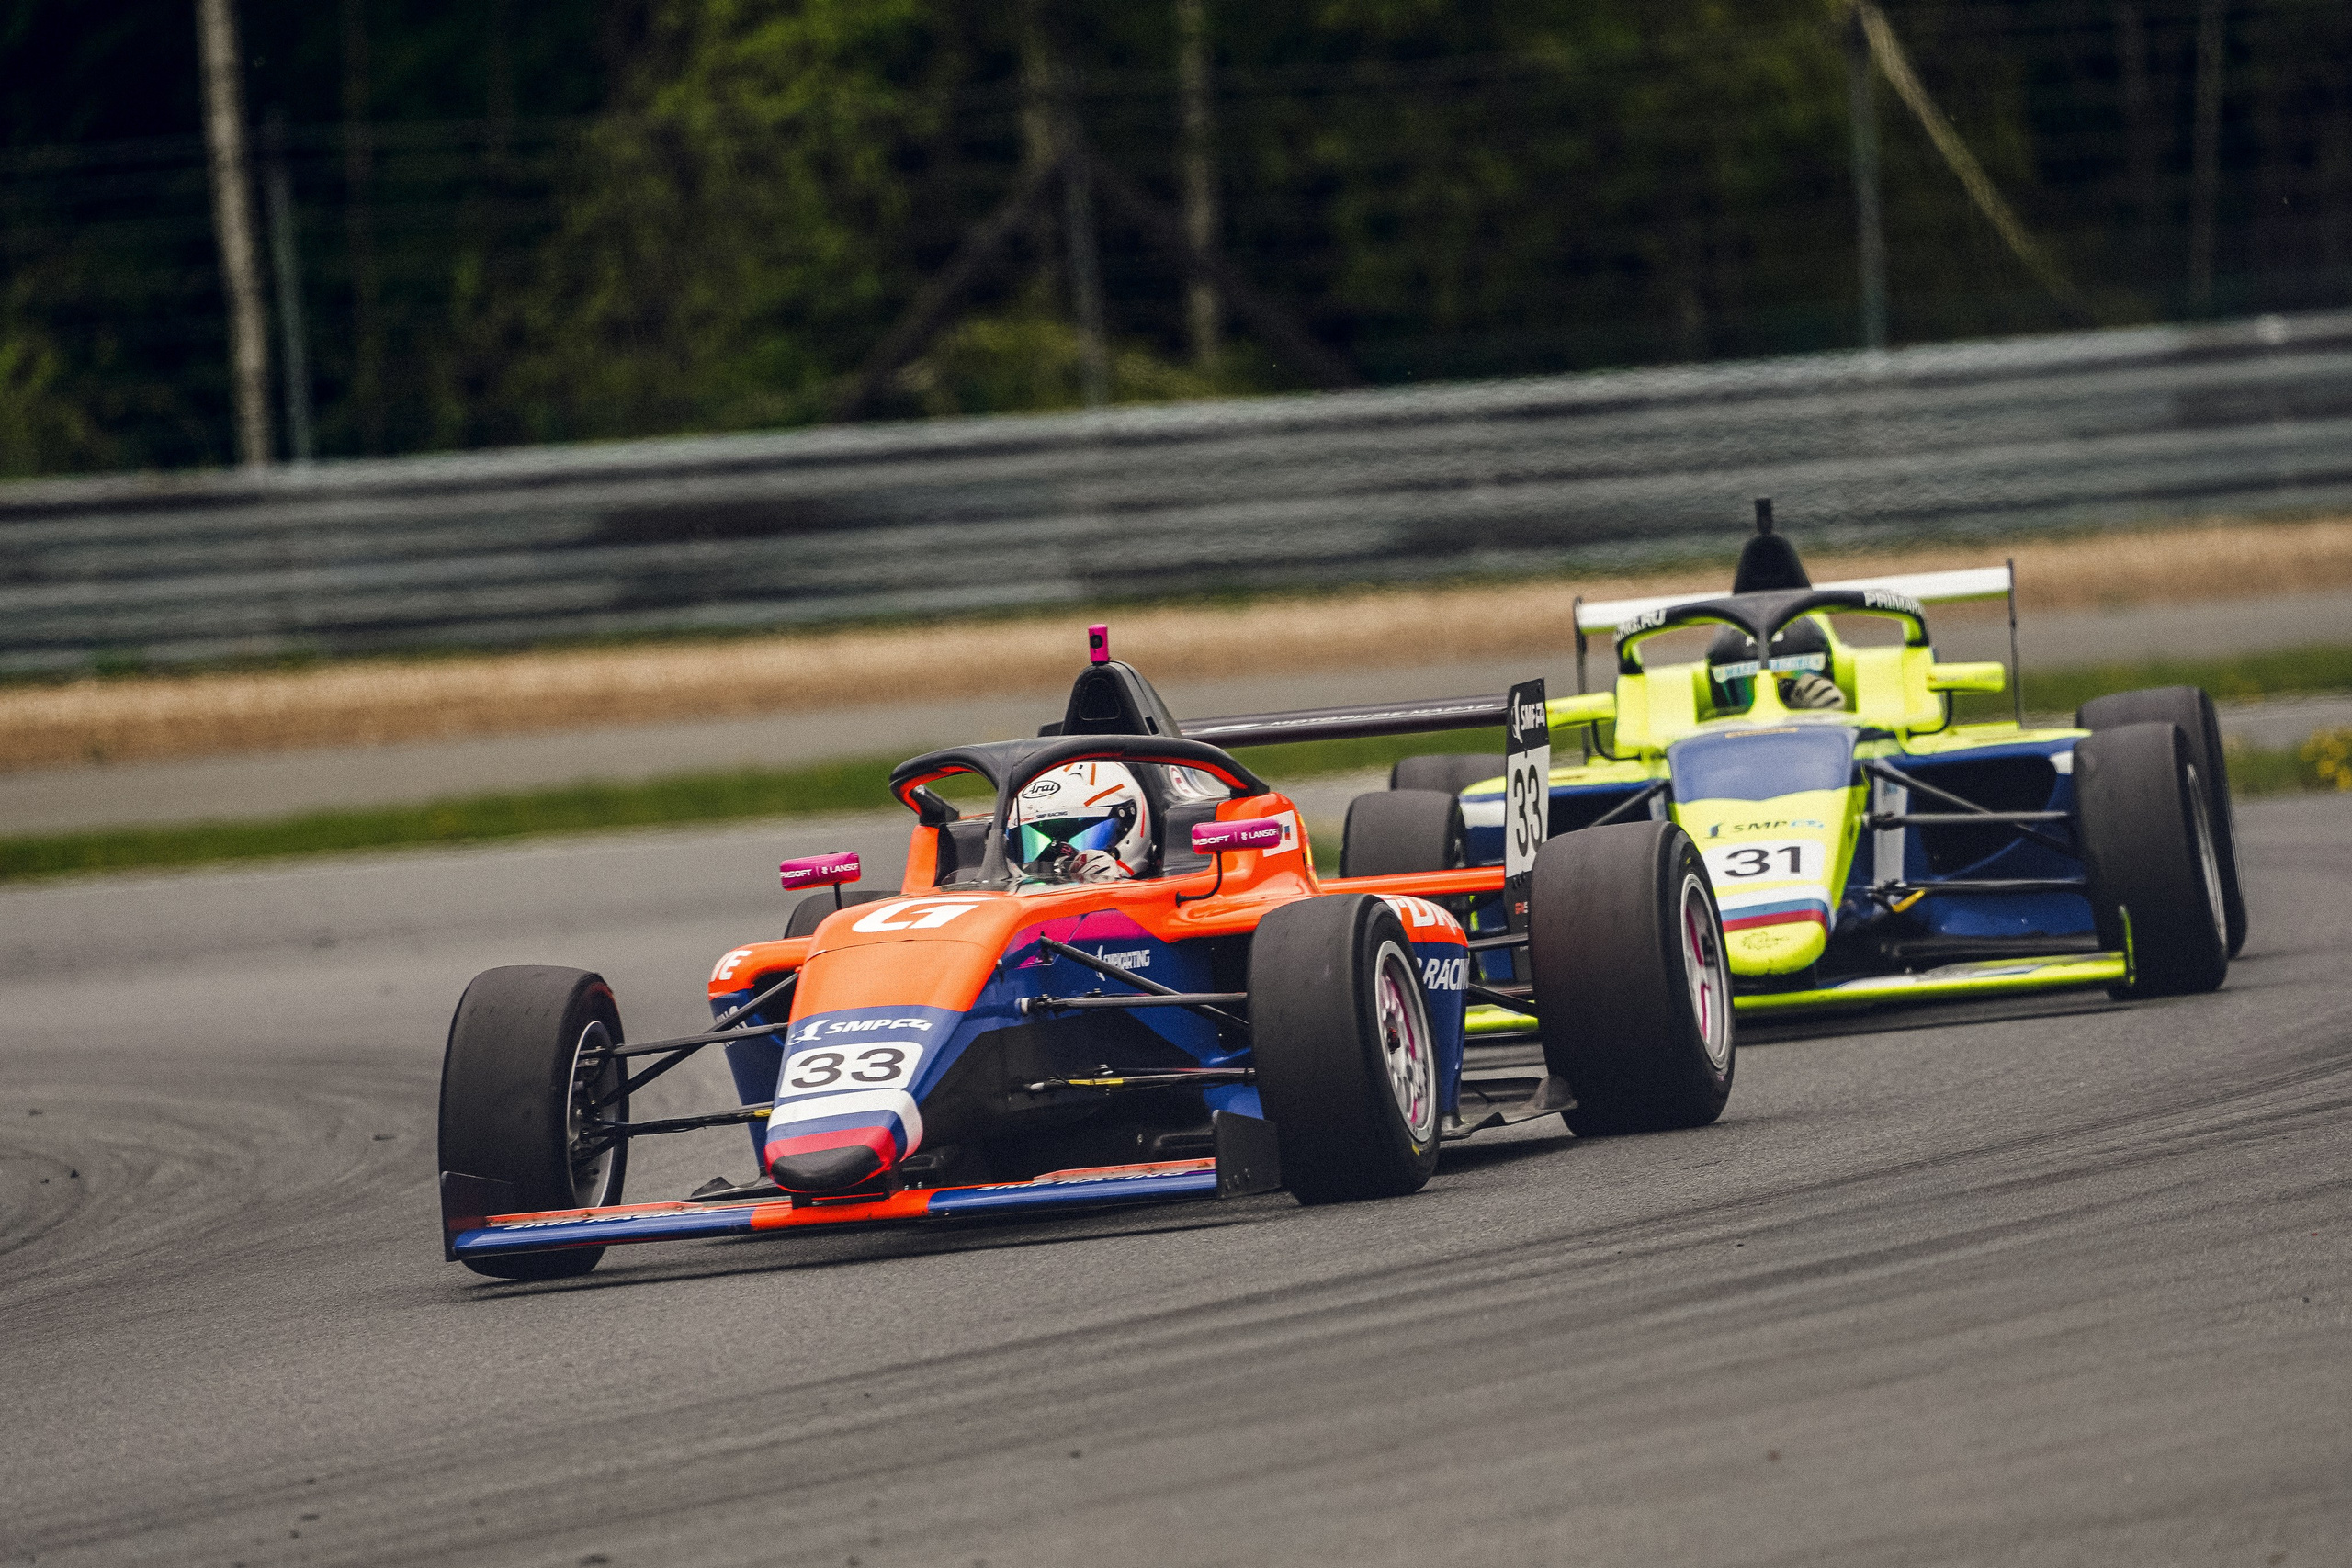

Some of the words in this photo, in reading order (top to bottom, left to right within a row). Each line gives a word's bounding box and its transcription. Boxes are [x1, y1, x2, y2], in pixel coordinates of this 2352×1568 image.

[1029, 783, 1057, 794] Arai
[1514, 764, 1543, 858] 33
[1724, 846, 1801, 878] 31
[791, 1048, 906, 1089] 33
